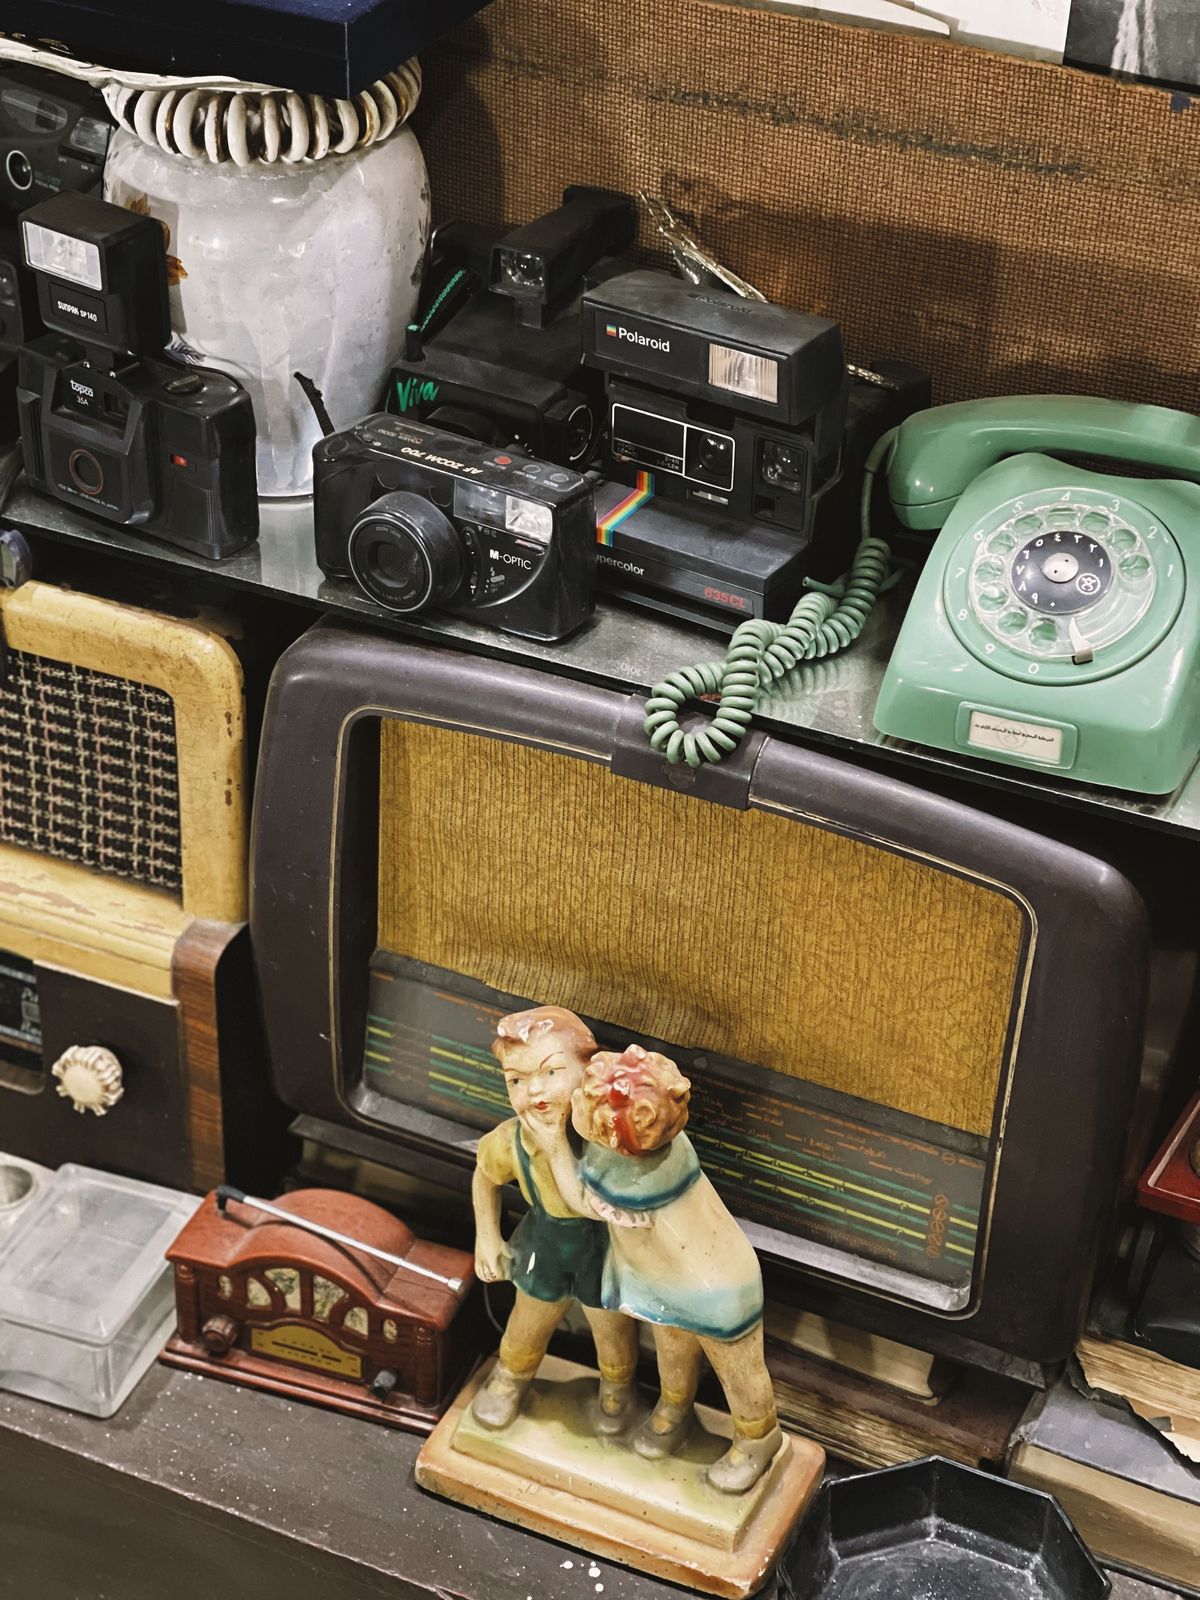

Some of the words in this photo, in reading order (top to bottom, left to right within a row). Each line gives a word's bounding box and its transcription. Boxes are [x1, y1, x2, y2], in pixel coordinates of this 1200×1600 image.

[618, 326, 670, 353] Polaroid
[70, 379, 94, 398] topca
[396, 376, 440, 412] Viva
[400, 446, 427, 458] 700
[424, 454, 465, 470] ZOOM
[462, 466, 484, 475] AF
[1060, 491, 1072, 501] 4
[1012, 501, 1024, 514] 5
[1110, 499, 1121, 512] 3
[974, 529, 985, 541] 6
[1147, 526, 1158, 539] 2
[489, 548, 532, 570] M-OPTIC
[596, 553, 645, 576] percolor
[954, 567, 966, 579] 7
[1167, 564, 1174, 577] 1
[703, 586, 746, 609] 635CL
[957, 608, 968, 621] 8
[985, 643, 996, 655] 9
[1028, 662, 1040, 675] 0
